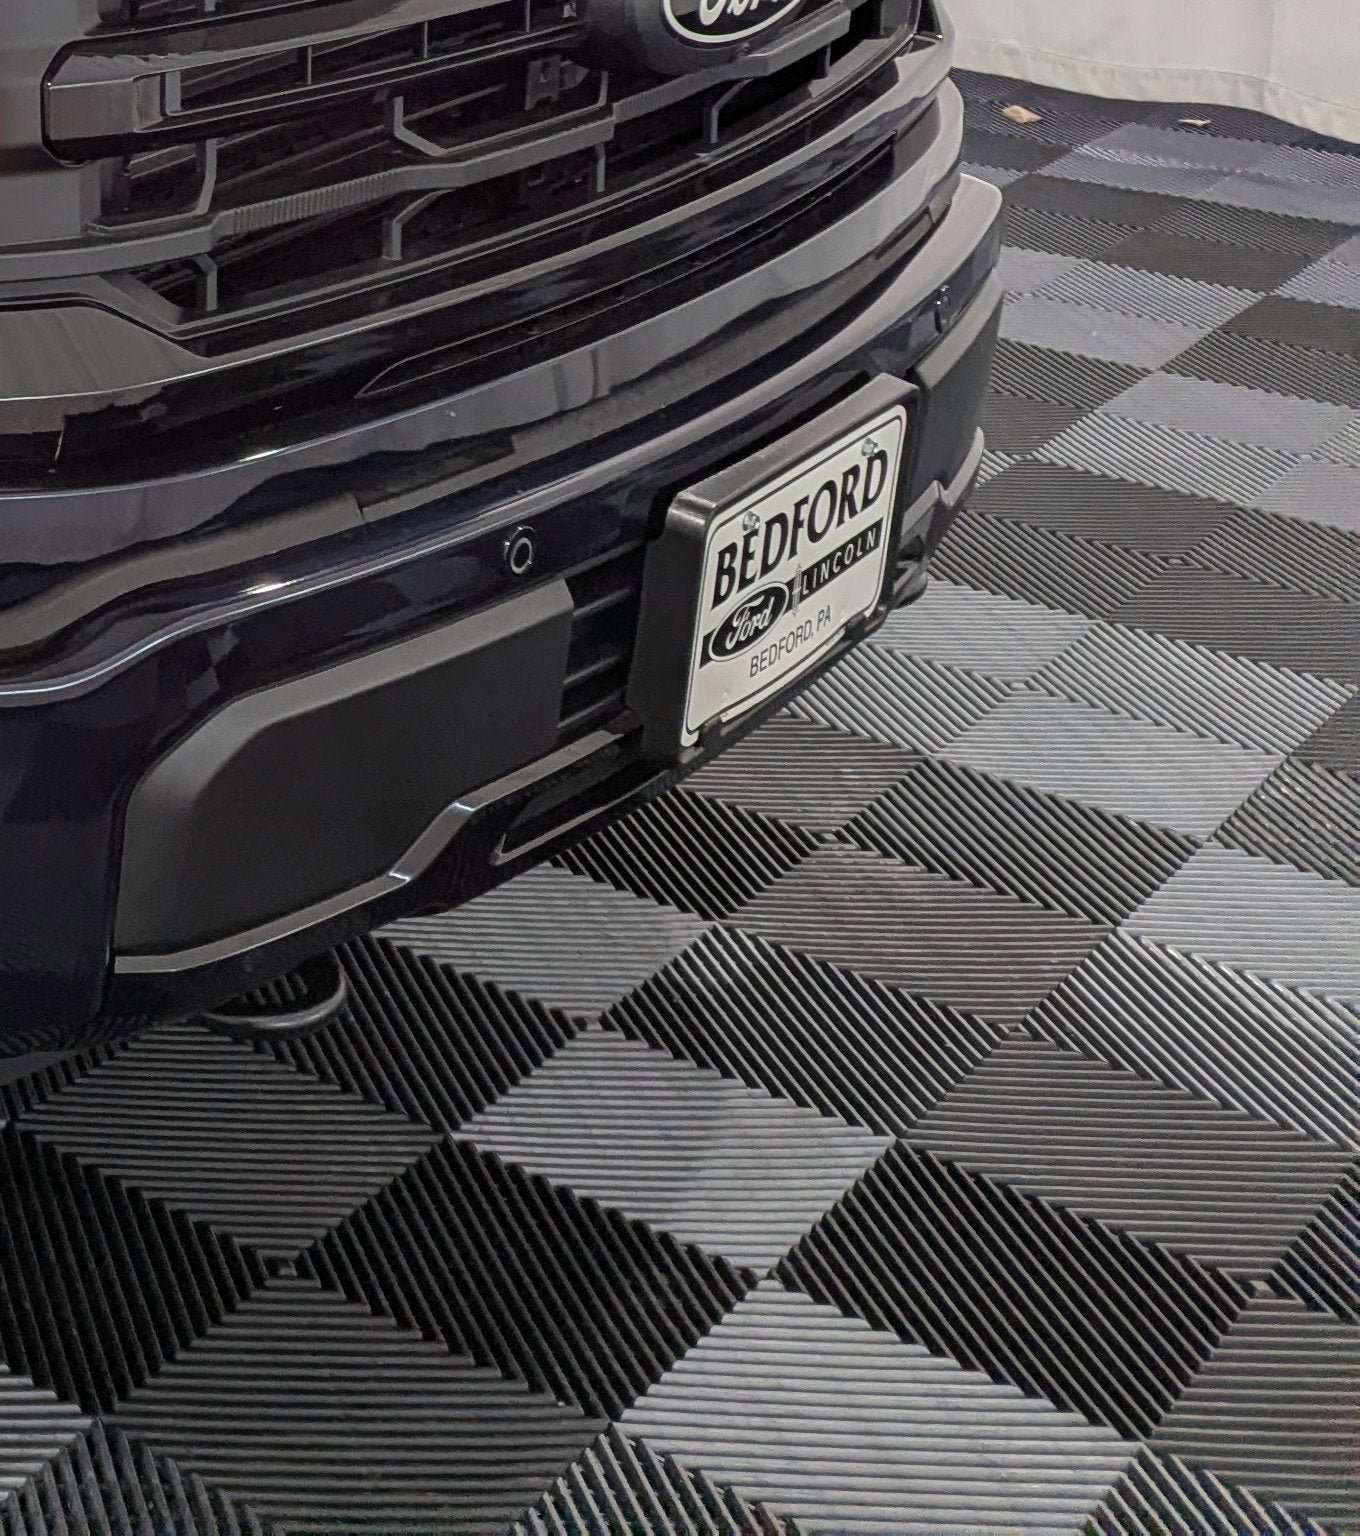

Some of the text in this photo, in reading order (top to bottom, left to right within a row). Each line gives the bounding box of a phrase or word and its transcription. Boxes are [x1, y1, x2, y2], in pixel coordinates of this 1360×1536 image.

[710, 448, 889, 611] BEDFORD
[725, 527, 877, 650] Ford LINCOLN
[749, 604, 831, 678] BEDFORD, PA
